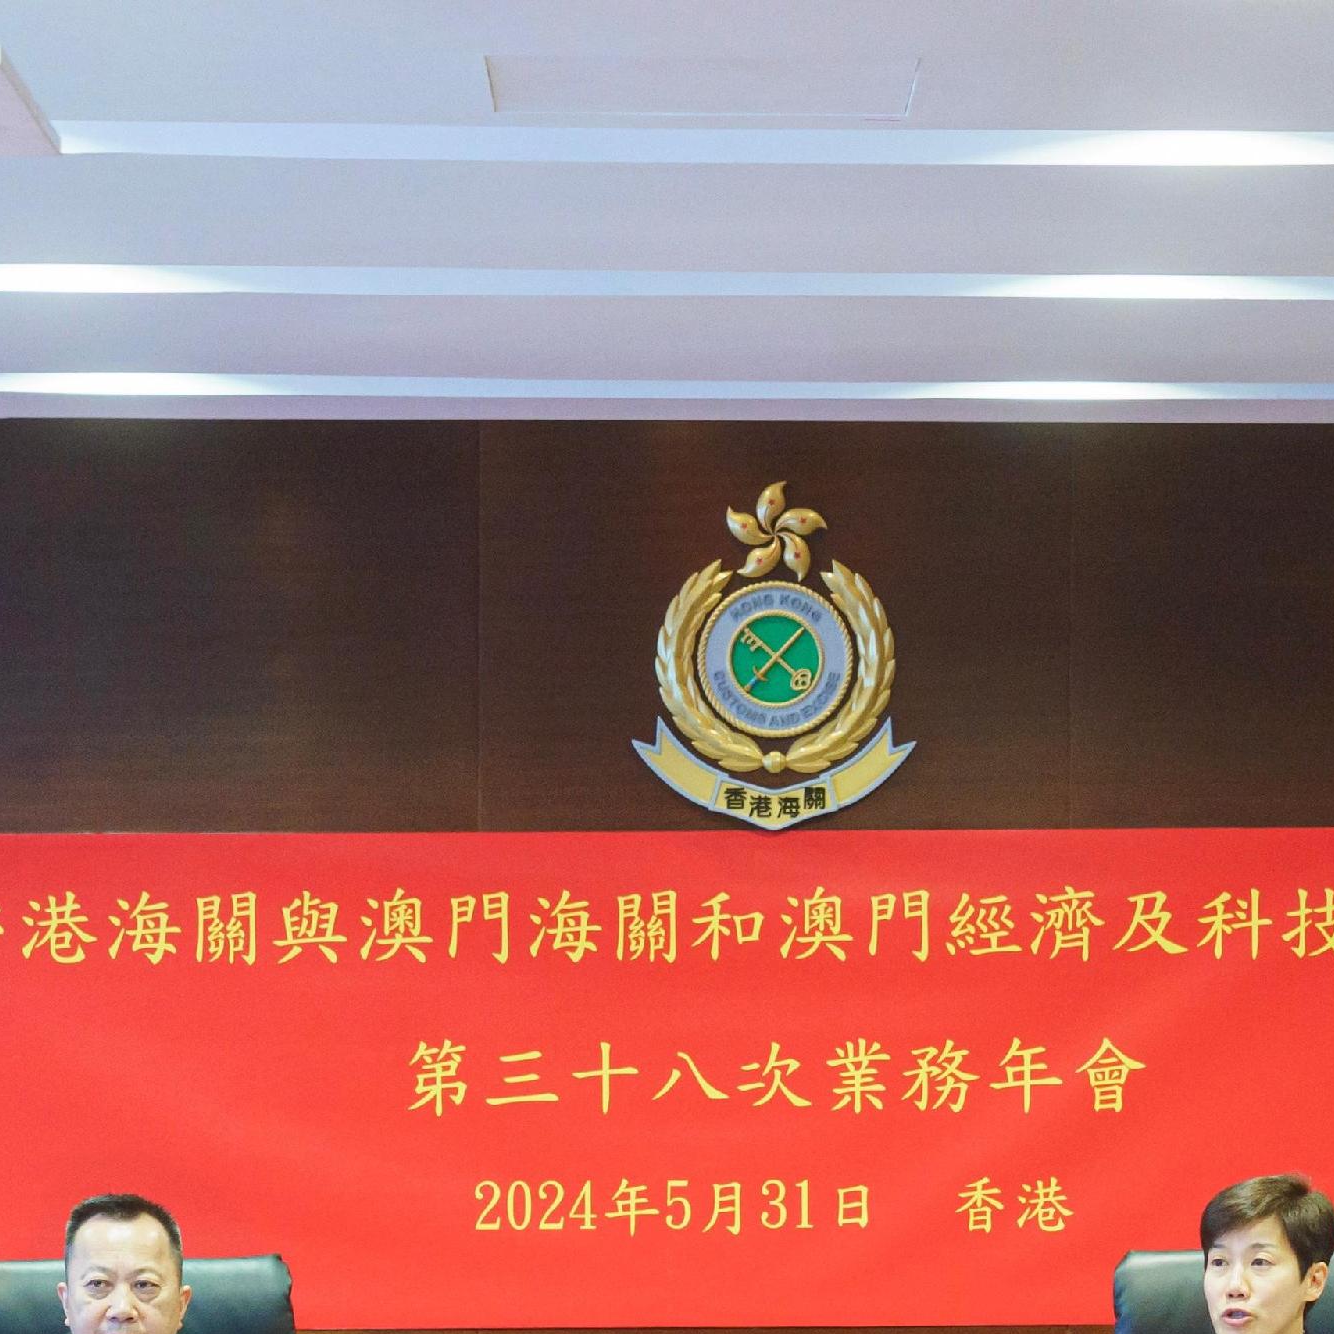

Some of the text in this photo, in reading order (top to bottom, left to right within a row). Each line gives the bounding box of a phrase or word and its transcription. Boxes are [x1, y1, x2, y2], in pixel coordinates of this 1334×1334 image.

[779, 593, 823, 622] KONG
[724, 785, 827, 818] 香港海關
[409, 1037, 1147, 1117] 第三十八次業務年會
[474, 1175, 1075, 1237] 2024年5月31日 香港
